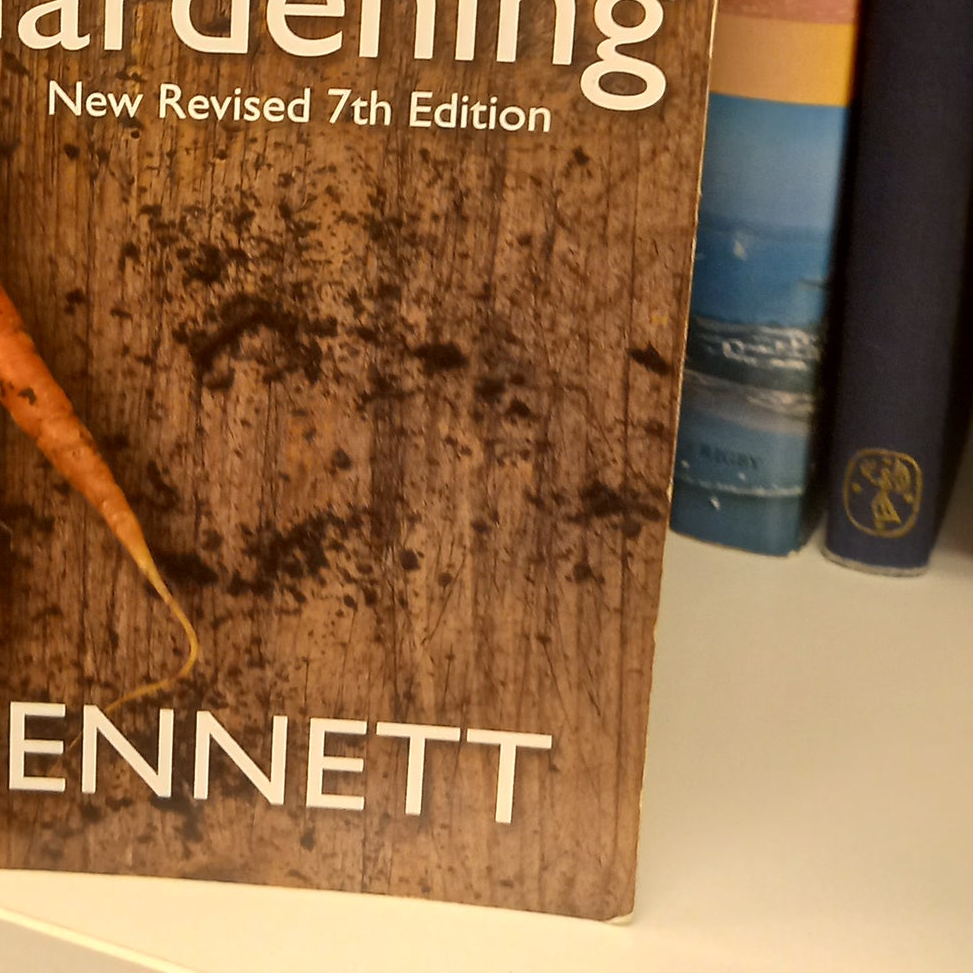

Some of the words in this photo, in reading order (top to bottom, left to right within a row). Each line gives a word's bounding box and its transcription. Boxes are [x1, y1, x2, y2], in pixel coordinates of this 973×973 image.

[47, 79, 144, 118] New
[158, 82, 312, 128] Revised
[327, 87, 393, 129] 7th
[408, 90, 552, 133] Edition
